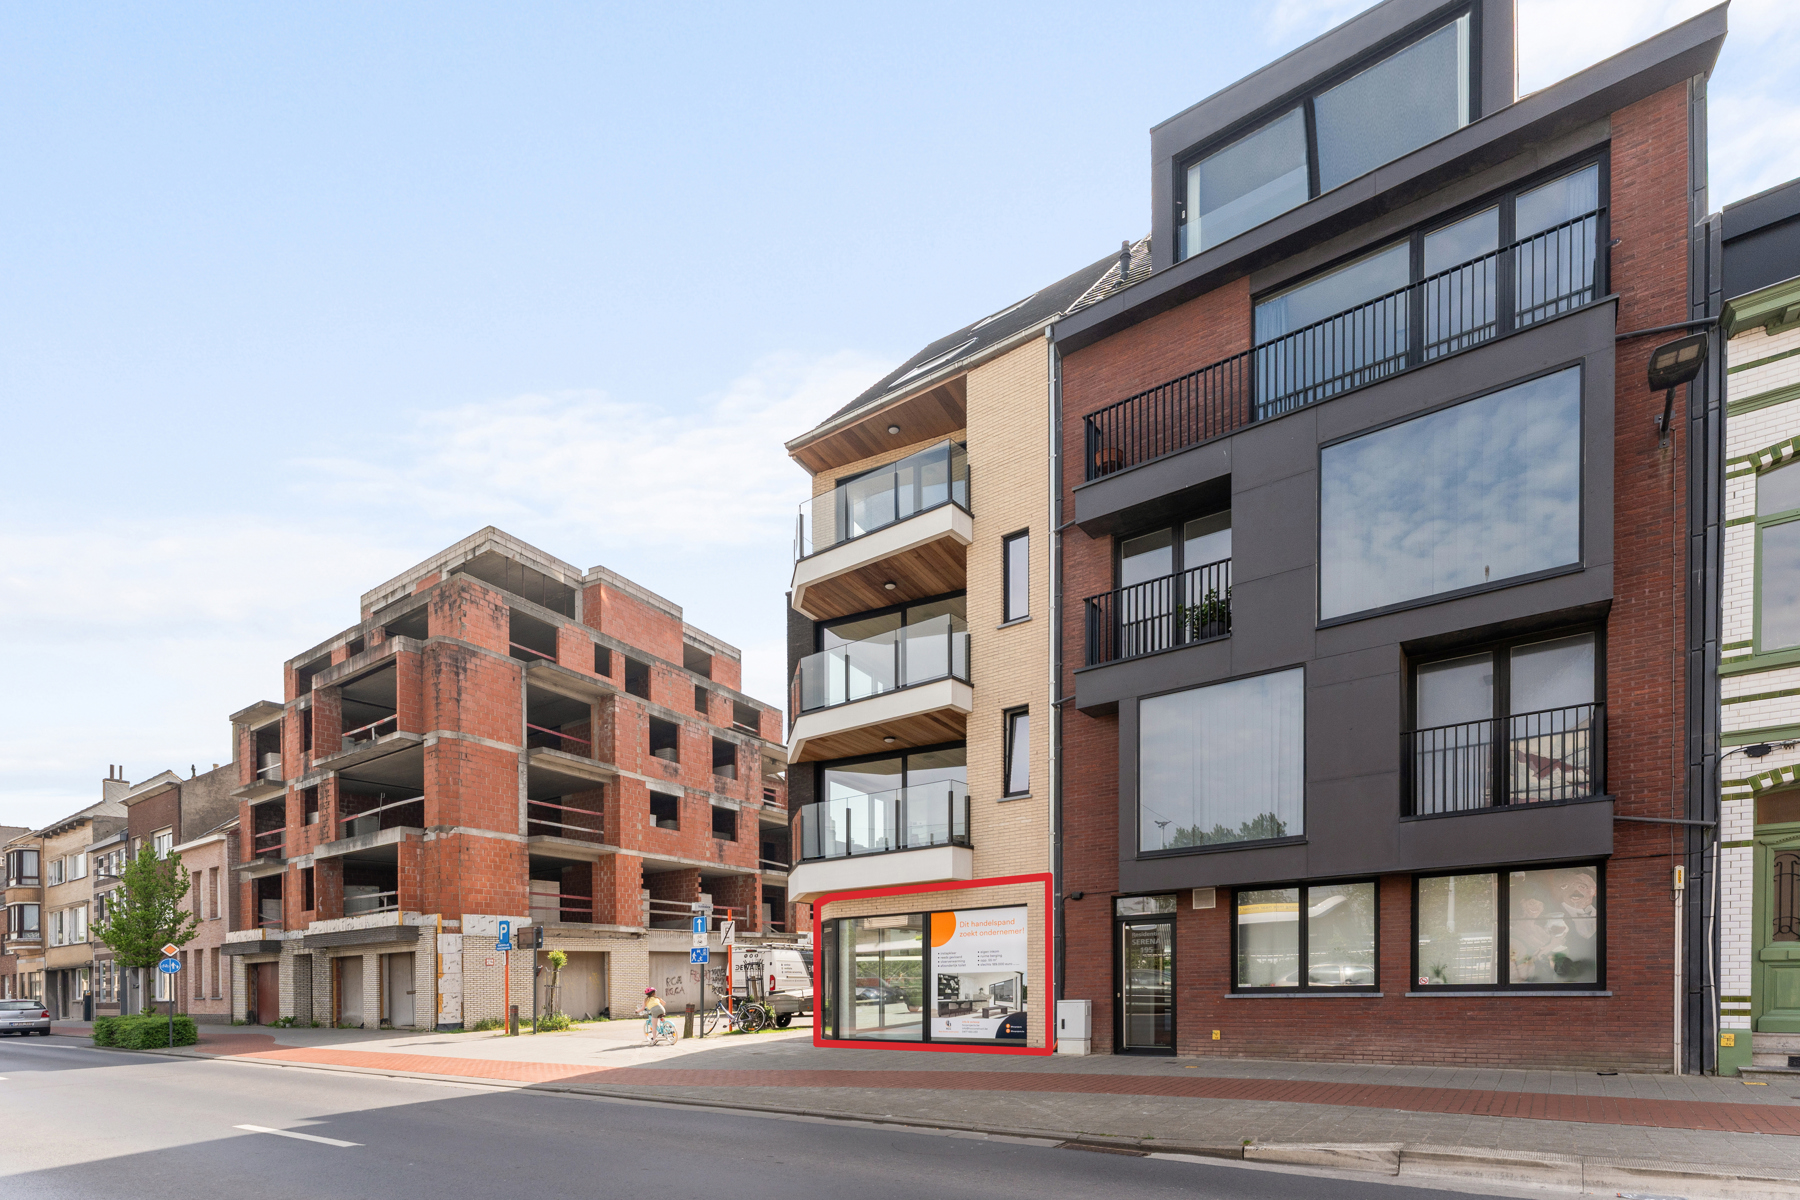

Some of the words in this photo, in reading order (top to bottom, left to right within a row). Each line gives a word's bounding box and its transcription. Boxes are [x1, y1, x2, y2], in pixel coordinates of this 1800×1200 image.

[959, 920, 969, 928] Dit
[971, 918, 1015, 927] handelspand
[500, 924, 508, 940] P
[979, 927, 1025, 936] ondernemer!
